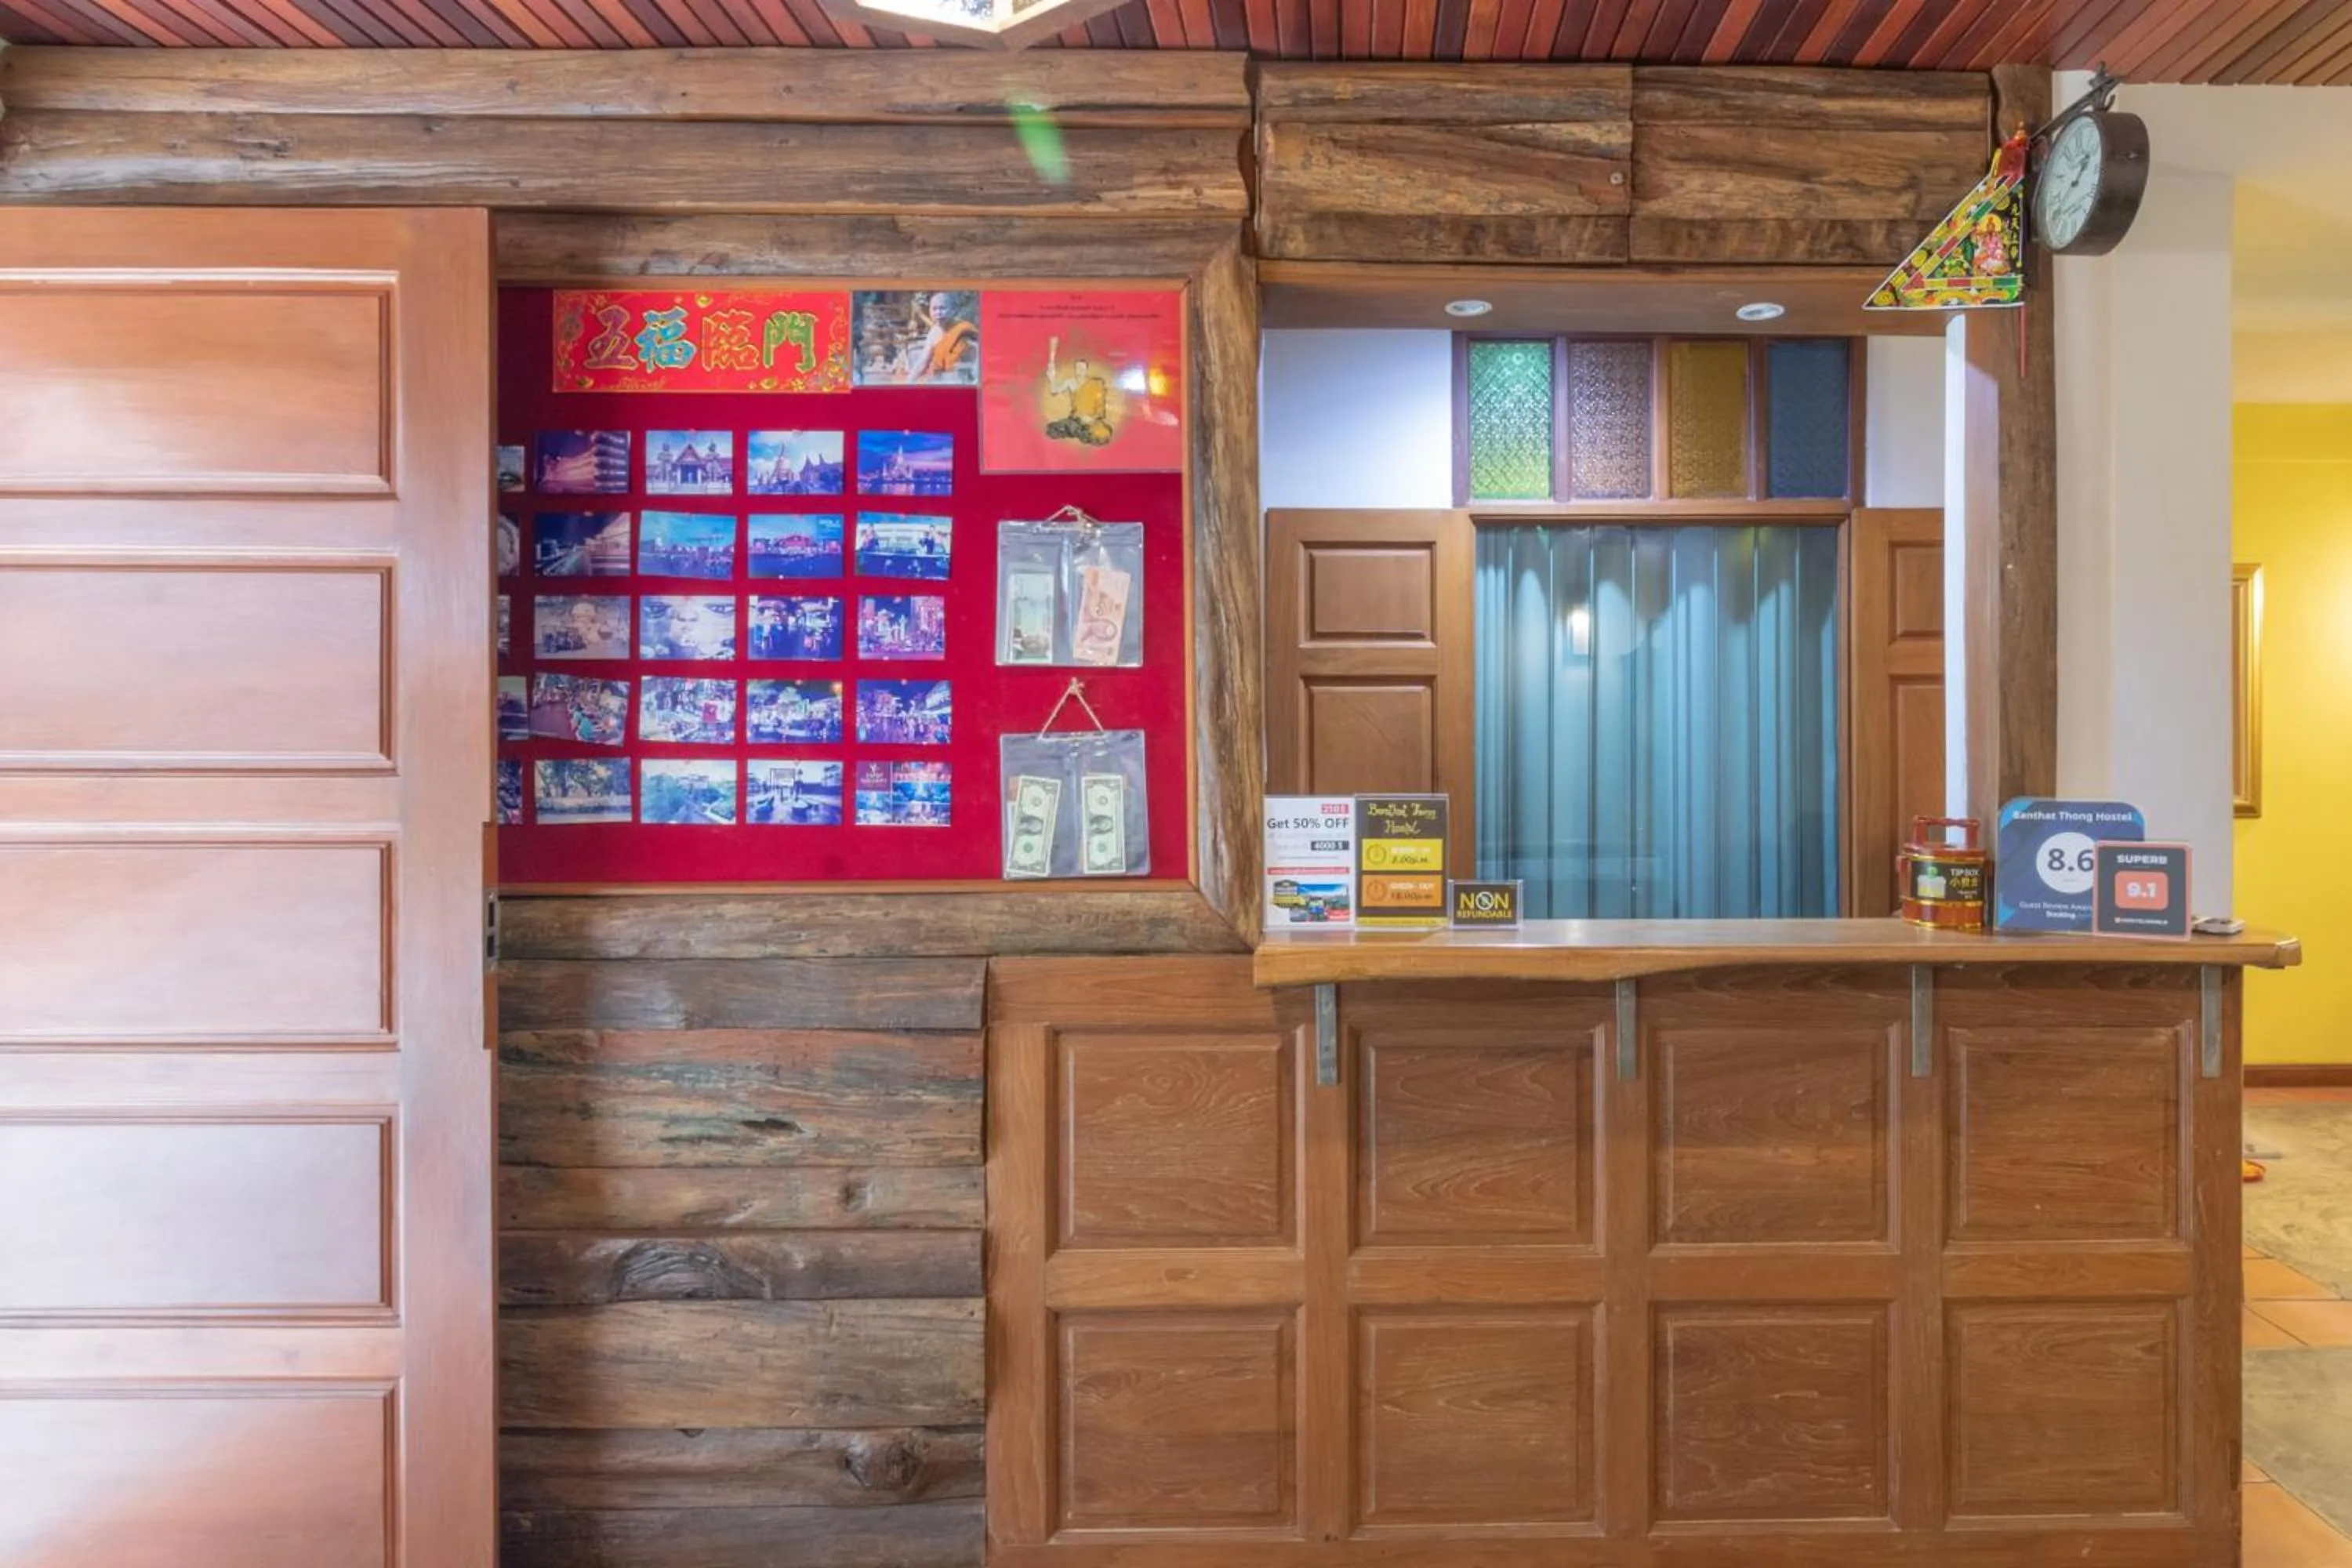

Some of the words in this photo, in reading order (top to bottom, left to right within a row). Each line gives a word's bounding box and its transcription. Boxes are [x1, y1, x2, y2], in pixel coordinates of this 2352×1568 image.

[584, 304, 818, 373] 五福臨門
[1267, 818, 1290, 829] Get
[1294, 818, 1321, 829] 50%
[1324, 818, 1349, 829] OFF
[2013, 811, 2056, 821] Banthat
[2060, 811, 2092, 822] Thong
[2096, 812, 2132, 822] Hostel
[2048, 848, 2094, 872] 8.6
[2117, 854, 2169, 864] SUPERB
[2126, 881, 2157, 898] 9.1
[1460, 891, 1509, 910] NON
